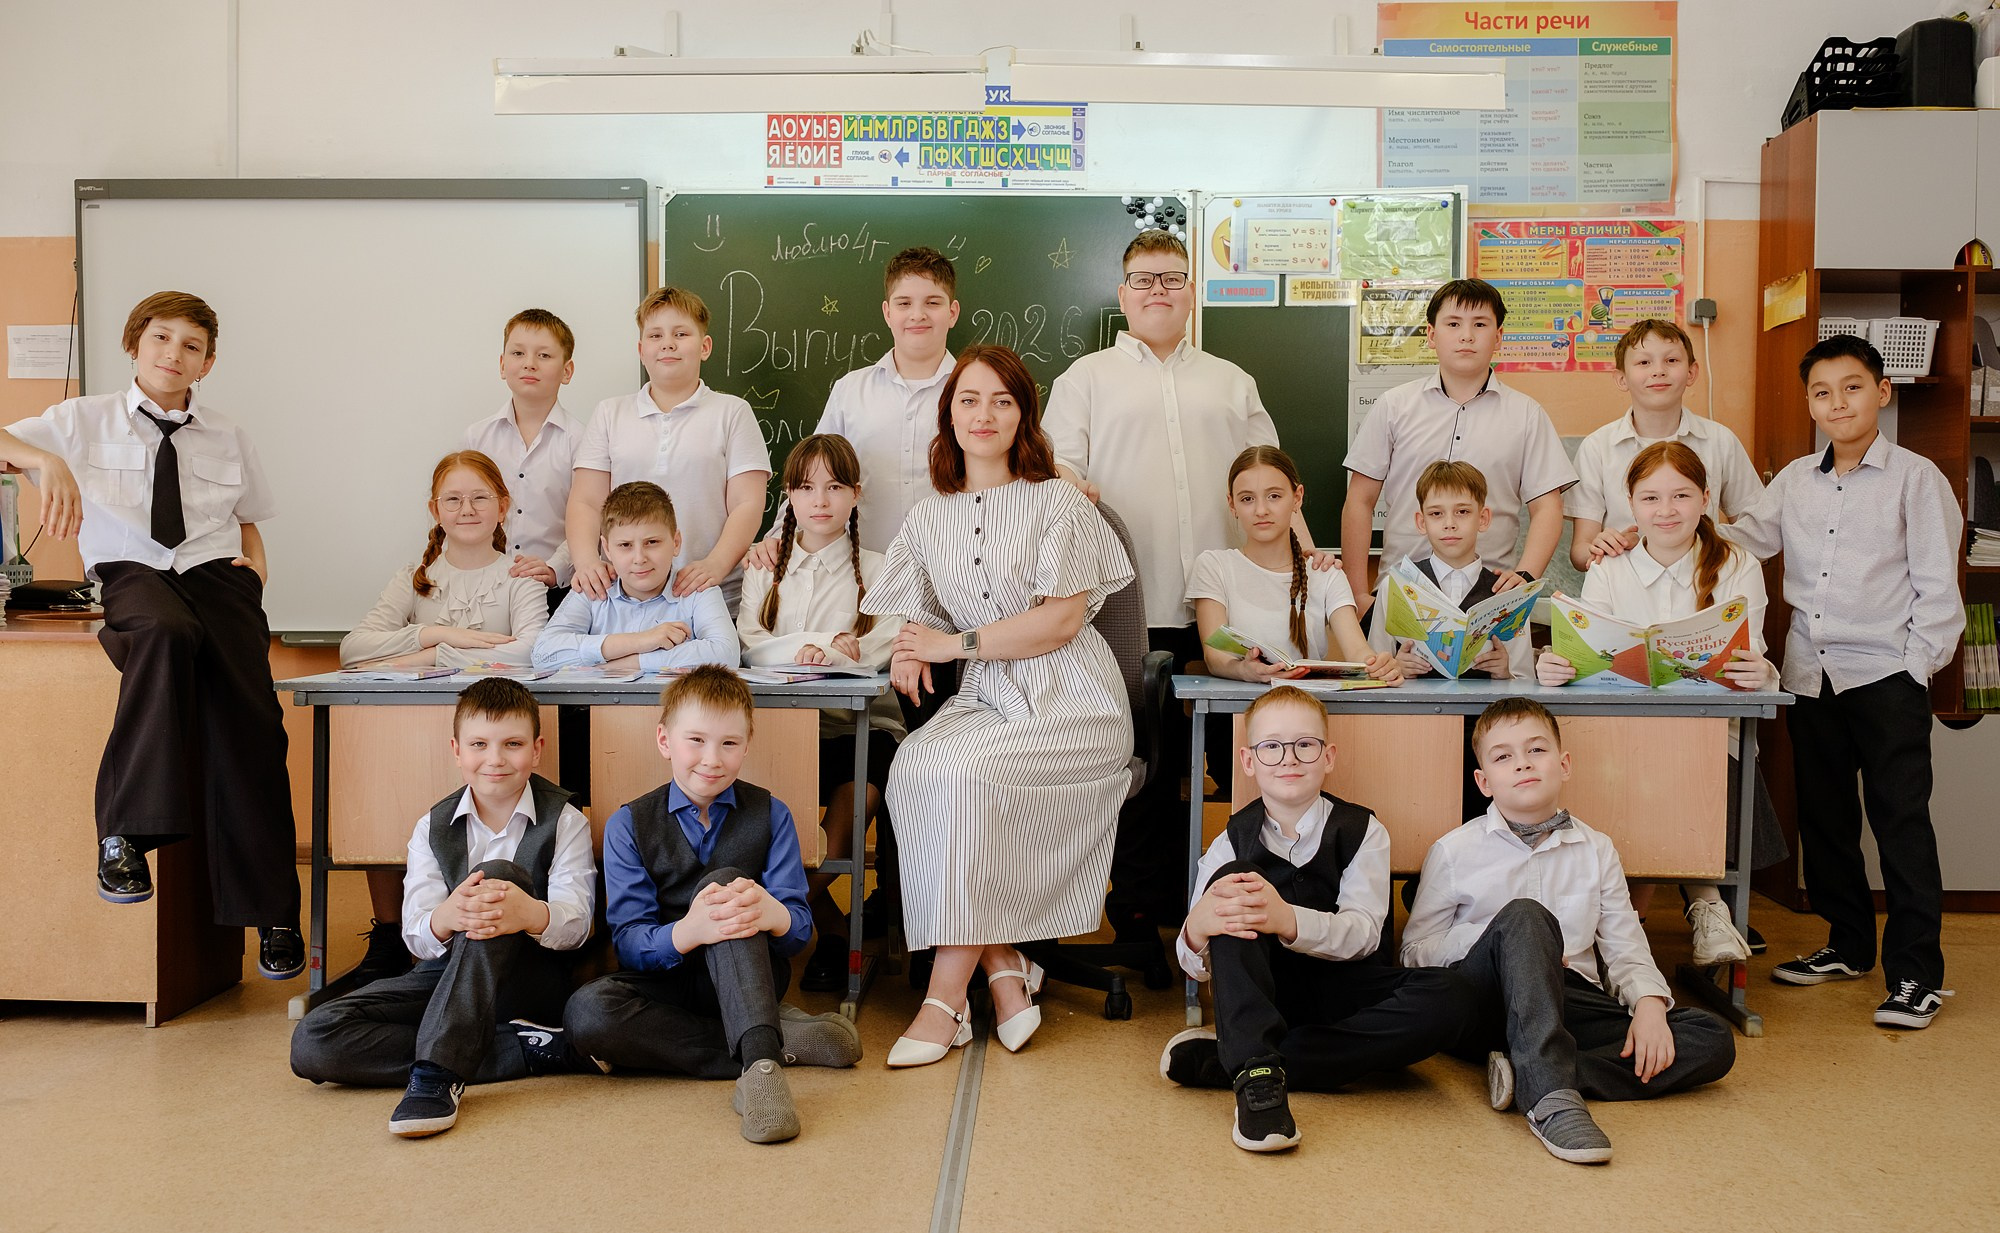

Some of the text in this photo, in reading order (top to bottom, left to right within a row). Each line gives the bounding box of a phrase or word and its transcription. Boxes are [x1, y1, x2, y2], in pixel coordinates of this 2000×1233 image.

[1465, 11, 1590, 34] Части речи
[1429, 42, 1531, 53] Самостоятельные
[1592, 41, 1658, 53] Служебные
[1584, 62, 1613, 70] Предлог
[1388, 136, 1441, 144] Местоимение
[1388, 160, 1414, 168] Глагол
[1529, 226, 1631, 235] МЕРЫ ВЕЛИЧИН
[720, 270, 881, 377] Выпус
[970, 303, 1084, 363] 2026
[1656, 634, 1713, 648] Русский
[1249, 1067, 1272, 1078] GSD
